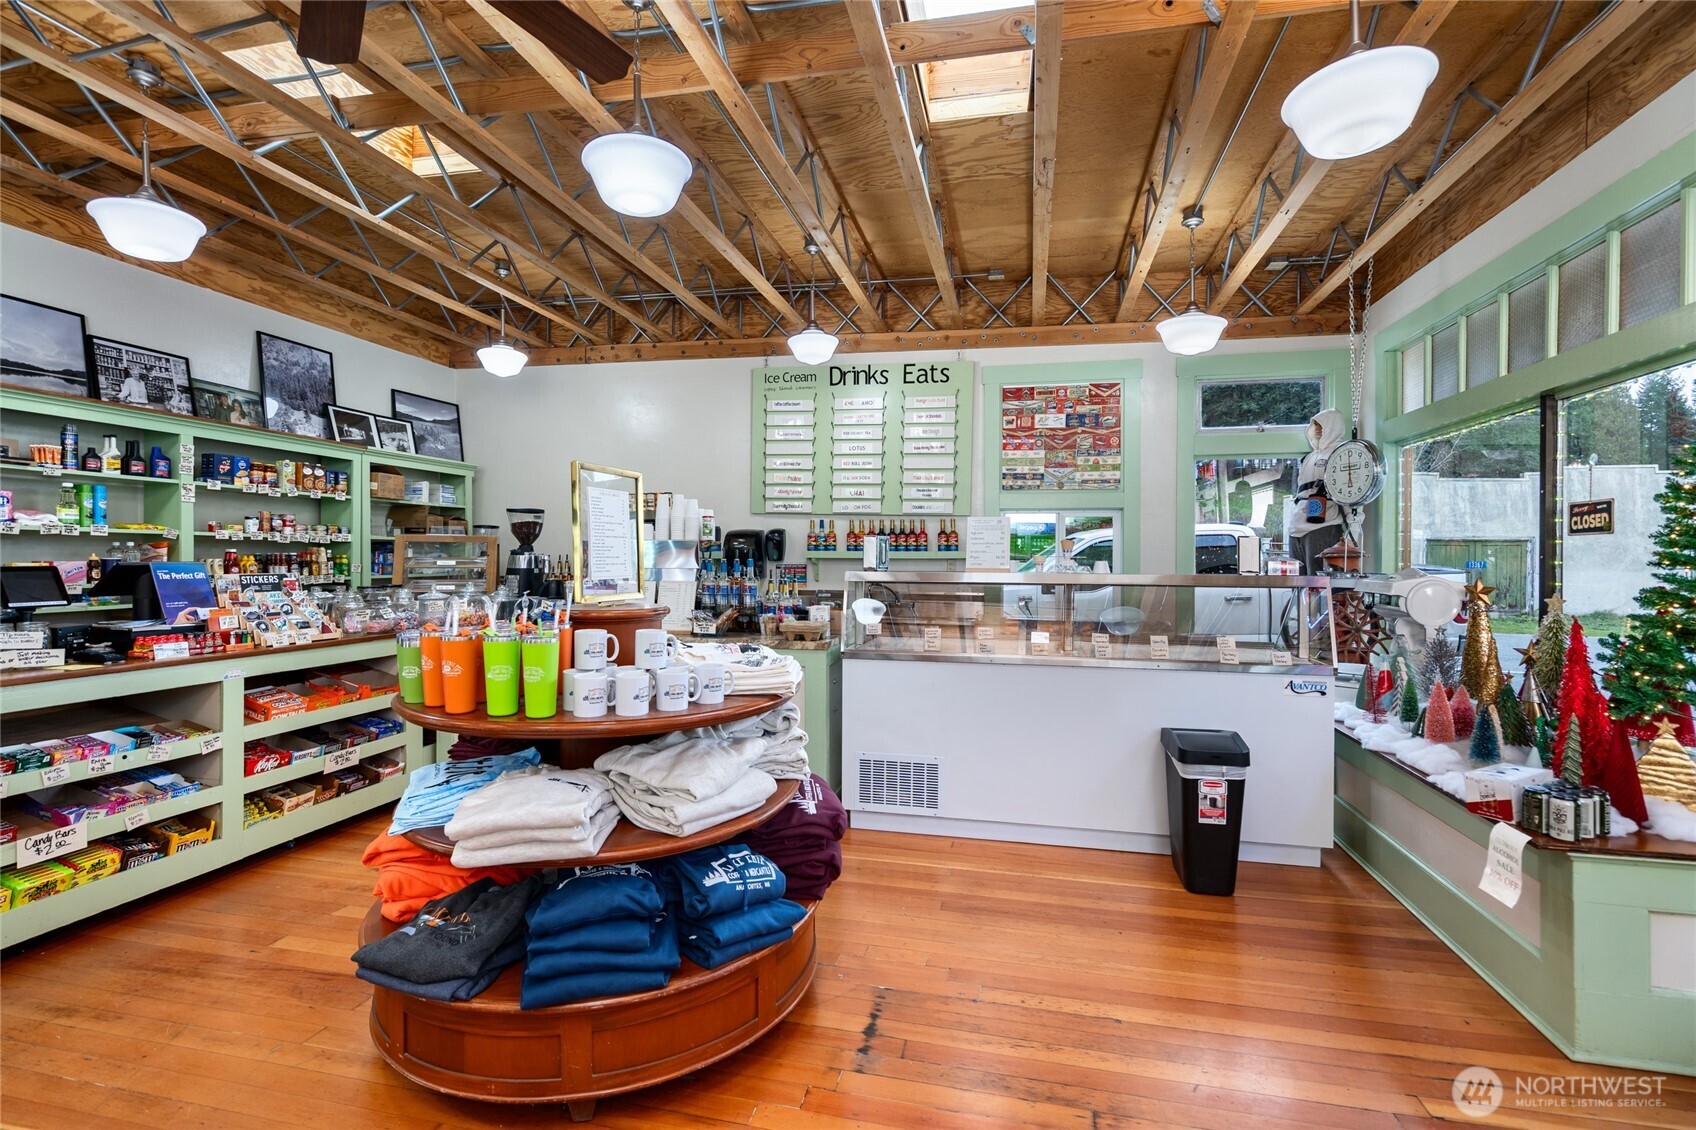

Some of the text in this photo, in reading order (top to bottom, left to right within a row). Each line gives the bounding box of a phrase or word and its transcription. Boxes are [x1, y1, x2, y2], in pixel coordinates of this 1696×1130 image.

[764, 371, 817, 383] Ice Cream
[829, 364, 889, 386] Drinks
[903, 363, 950, 384] Eats
[1571, 513, 1609, 530] CLOSED
[158, 572, 171, 580] The
[194, 571, 206, 579] Gift
[241, 575, 279, 584] STICKERS
[1284, 680, 1327, 694] AVANTCO
[329, 752, 346, 762] Candy
[25, 828, 77, 850] Candy Bars
[1496, 859, 1514, 875] SALE
[1504, 877, 1519, 891] OFF
